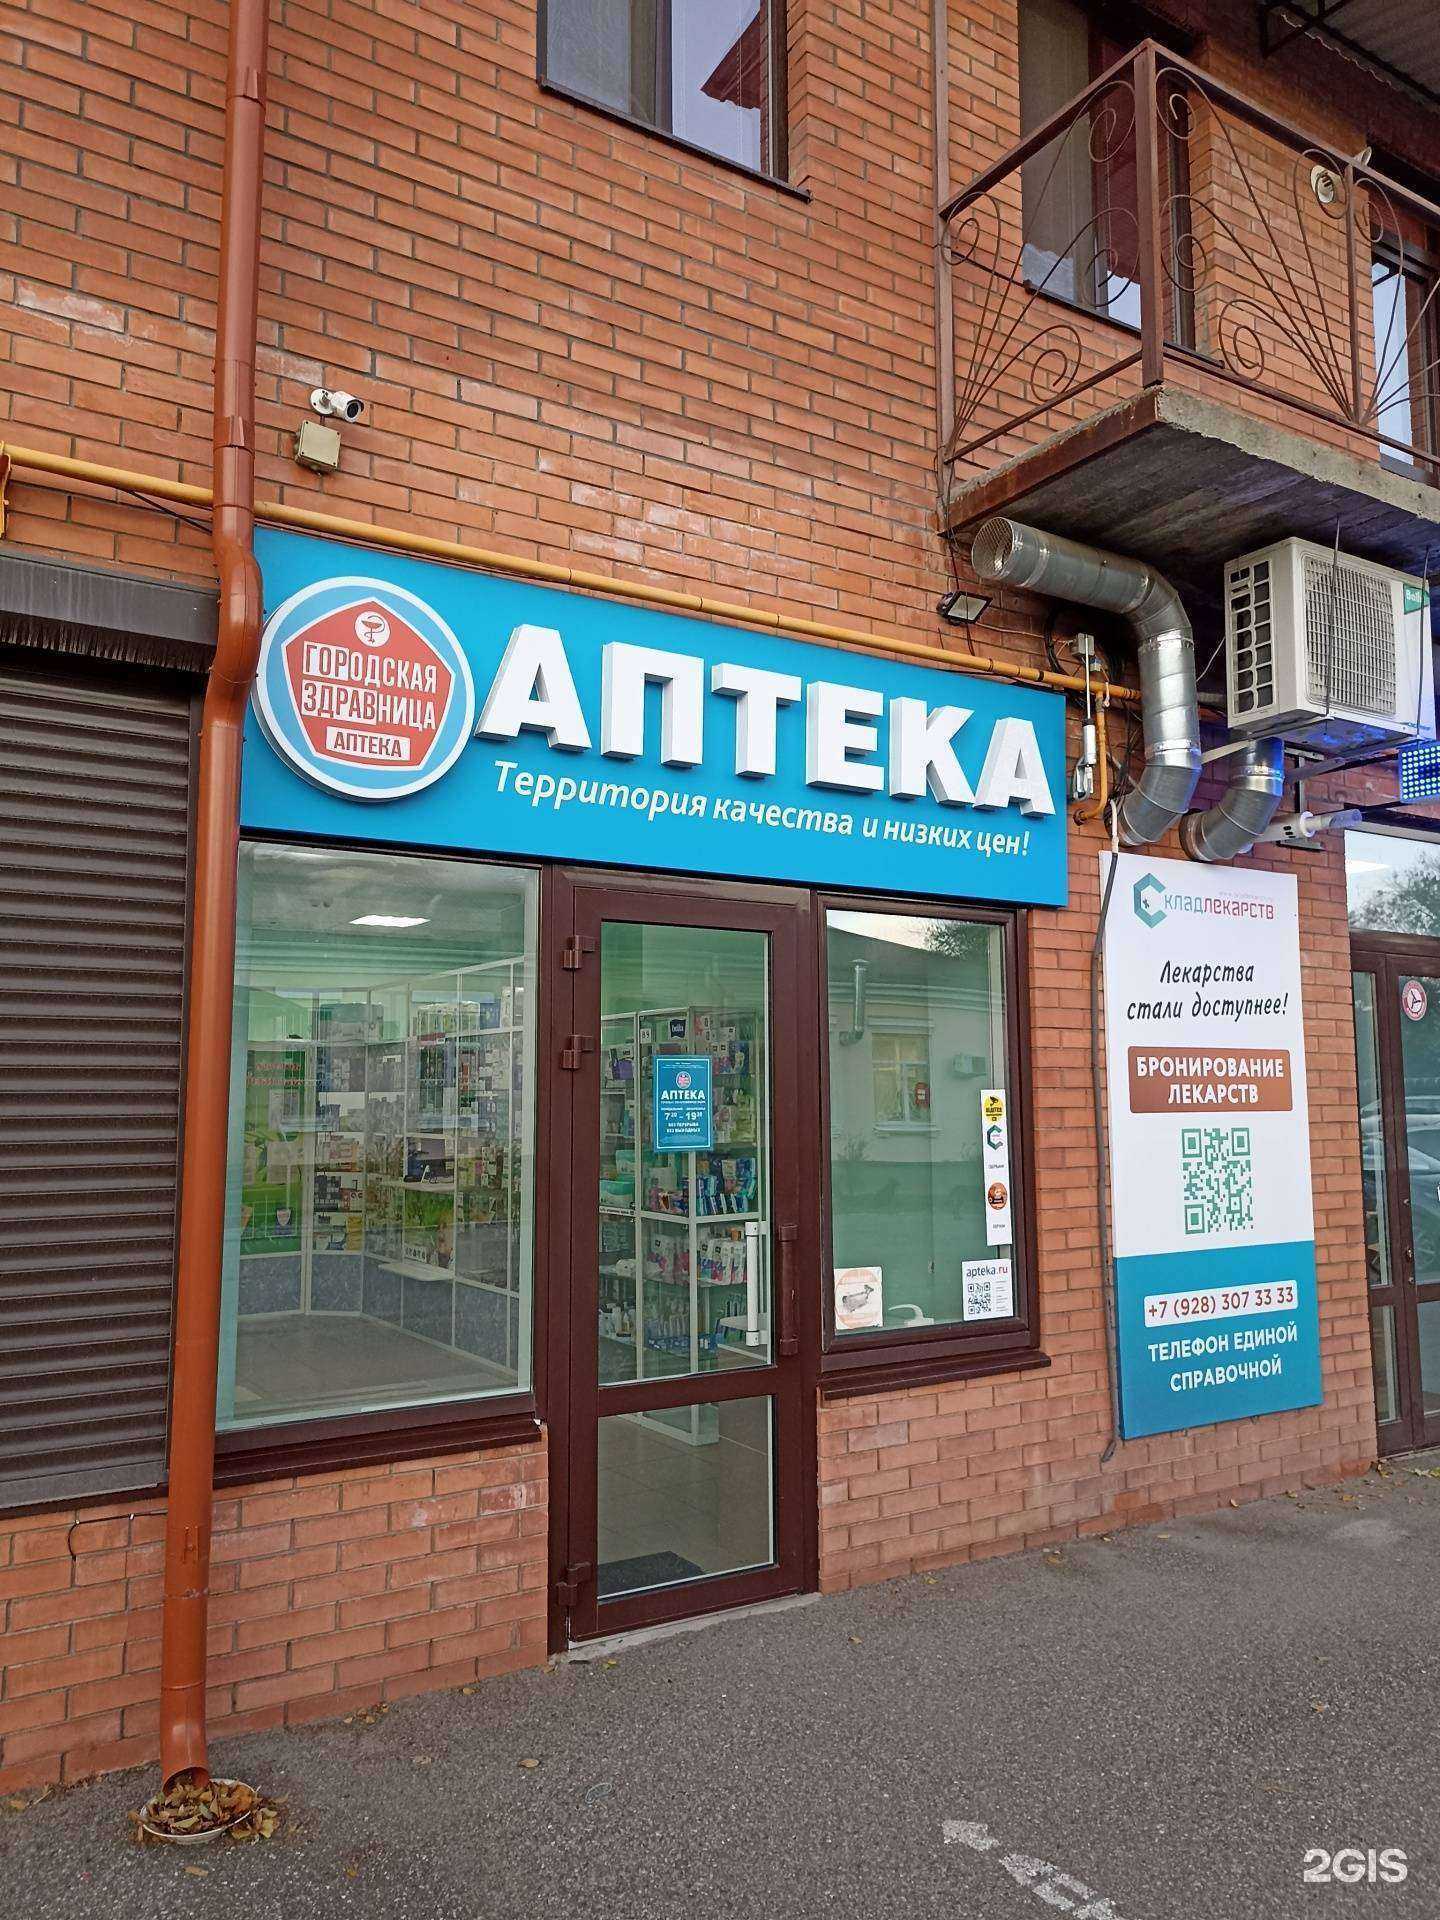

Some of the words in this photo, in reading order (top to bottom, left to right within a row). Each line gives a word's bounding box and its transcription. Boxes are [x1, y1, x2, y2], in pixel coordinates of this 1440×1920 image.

[305, 644, 437, 694] ГОРОДСКАЯ
[303, 682, 437, 732] ЗДРАВНИЦА
[474, 623, 1057, 817] АПТЕКА
[333, 731, 402, 758] АПТЕКА
[494, 760, 707, 822] Территория
[712, 797, 854, 836] качества
[862, 816, 878, 839] и
[883, 818, 972, 850] низких
[976, 830, 1030, 858] цен!
[1159, 959, 1255, 988] Лекарства
[1127, 1000, 1183, 1020] стали
[1191, 991, 1289, 1022] доступнее!
[1136, 1056, 1284, 1077] БРОНИРОВАНИЕ
[661, 1090, 706, 1100] АПТЕКА
[1168, 1083, 1259, 1104] ЛЕКАРСТВ
[966, 1265, 1008, 1279] apteka.ru
[1148, 1300, 1168, 1319] +7
[1173, 1295, 1216, 1318] (928)
[1221, 1291, 1250, 1311] 307
[1254, 1288, 1272, 1307] 33
[1276, 1286, 1294, 1304] 33
[1147, 1334, 1229, 1362] ТЕЛЕФОН
[1233, 1321, 1298, 1352] ЕДИНОЙ
[1170, 1353, 1282, 1392] СПРАВОЧНОЙ
